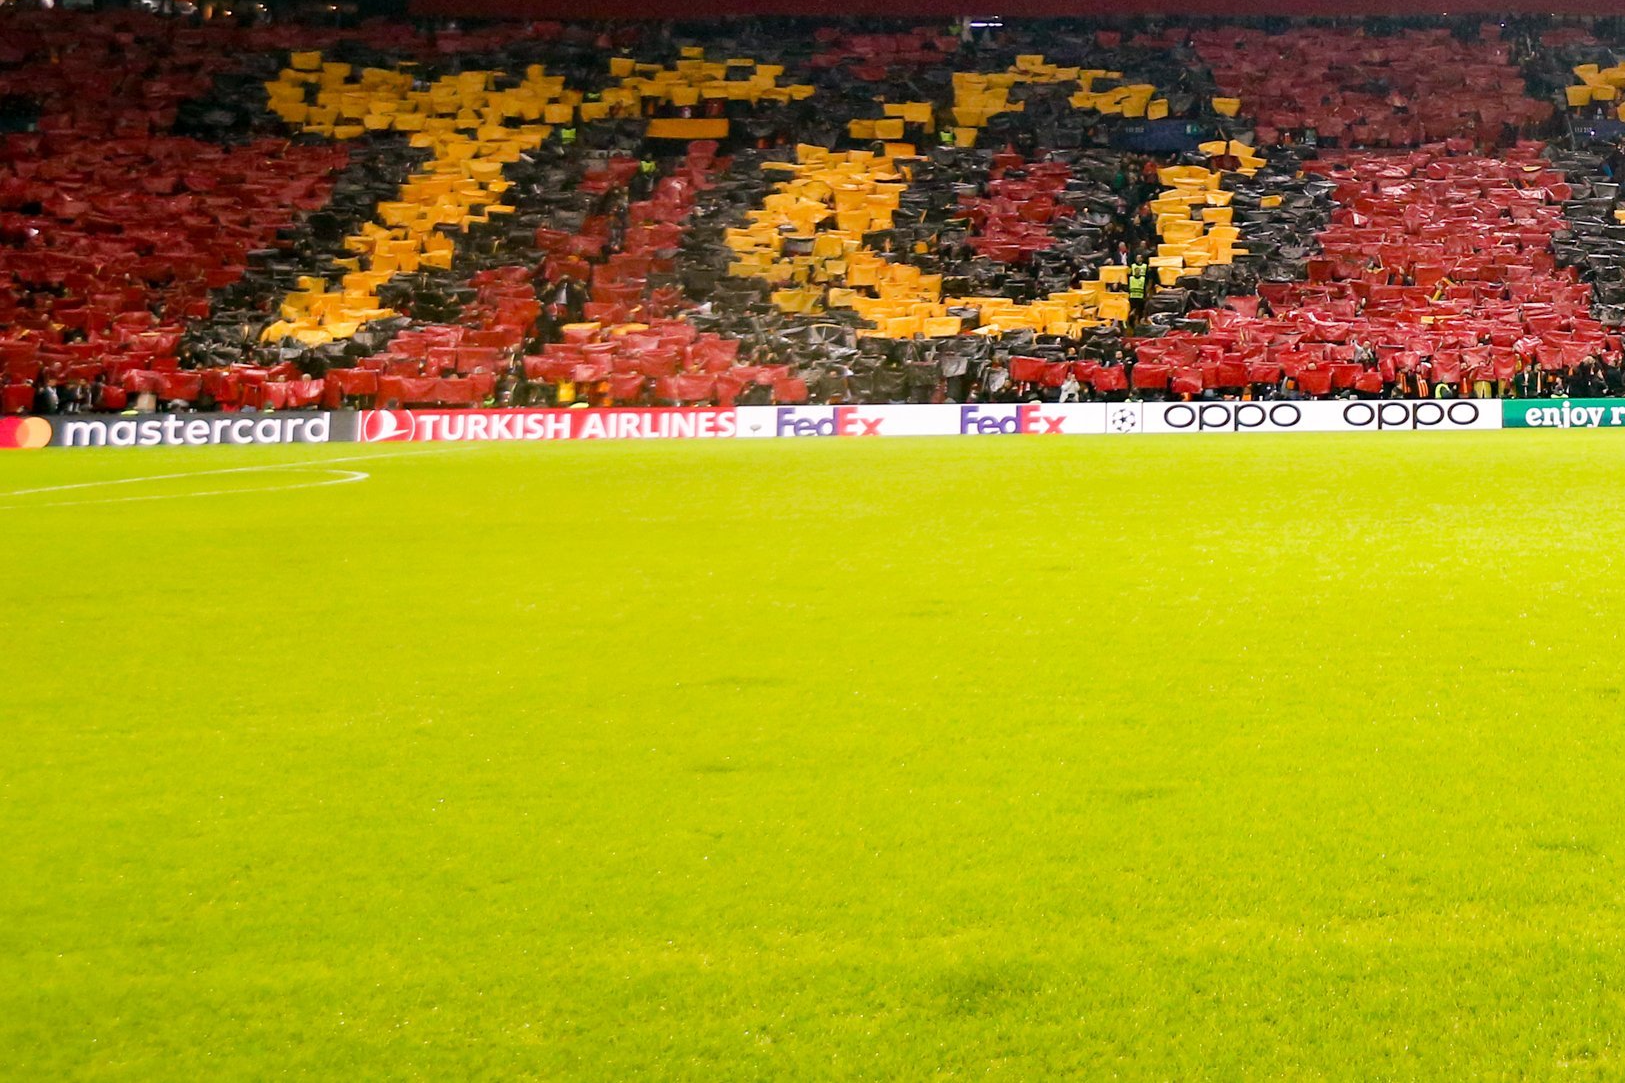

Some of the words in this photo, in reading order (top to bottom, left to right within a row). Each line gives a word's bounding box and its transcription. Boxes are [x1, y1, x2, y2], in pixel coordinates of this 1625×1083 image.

[64, 412, 331, 446] mastercard
[415, 412, 573, 441] TURKISH
[580, 411, 737, 439] AIRLINES
[776, 406, 886, 437] FedEx
[960, 404, 1067, 434] FedEx
[1164, 403, 1301, 432] oppo
[1343, 402, 1480, 430] oppo
[1525, 401, 1605, 428] enjoy
